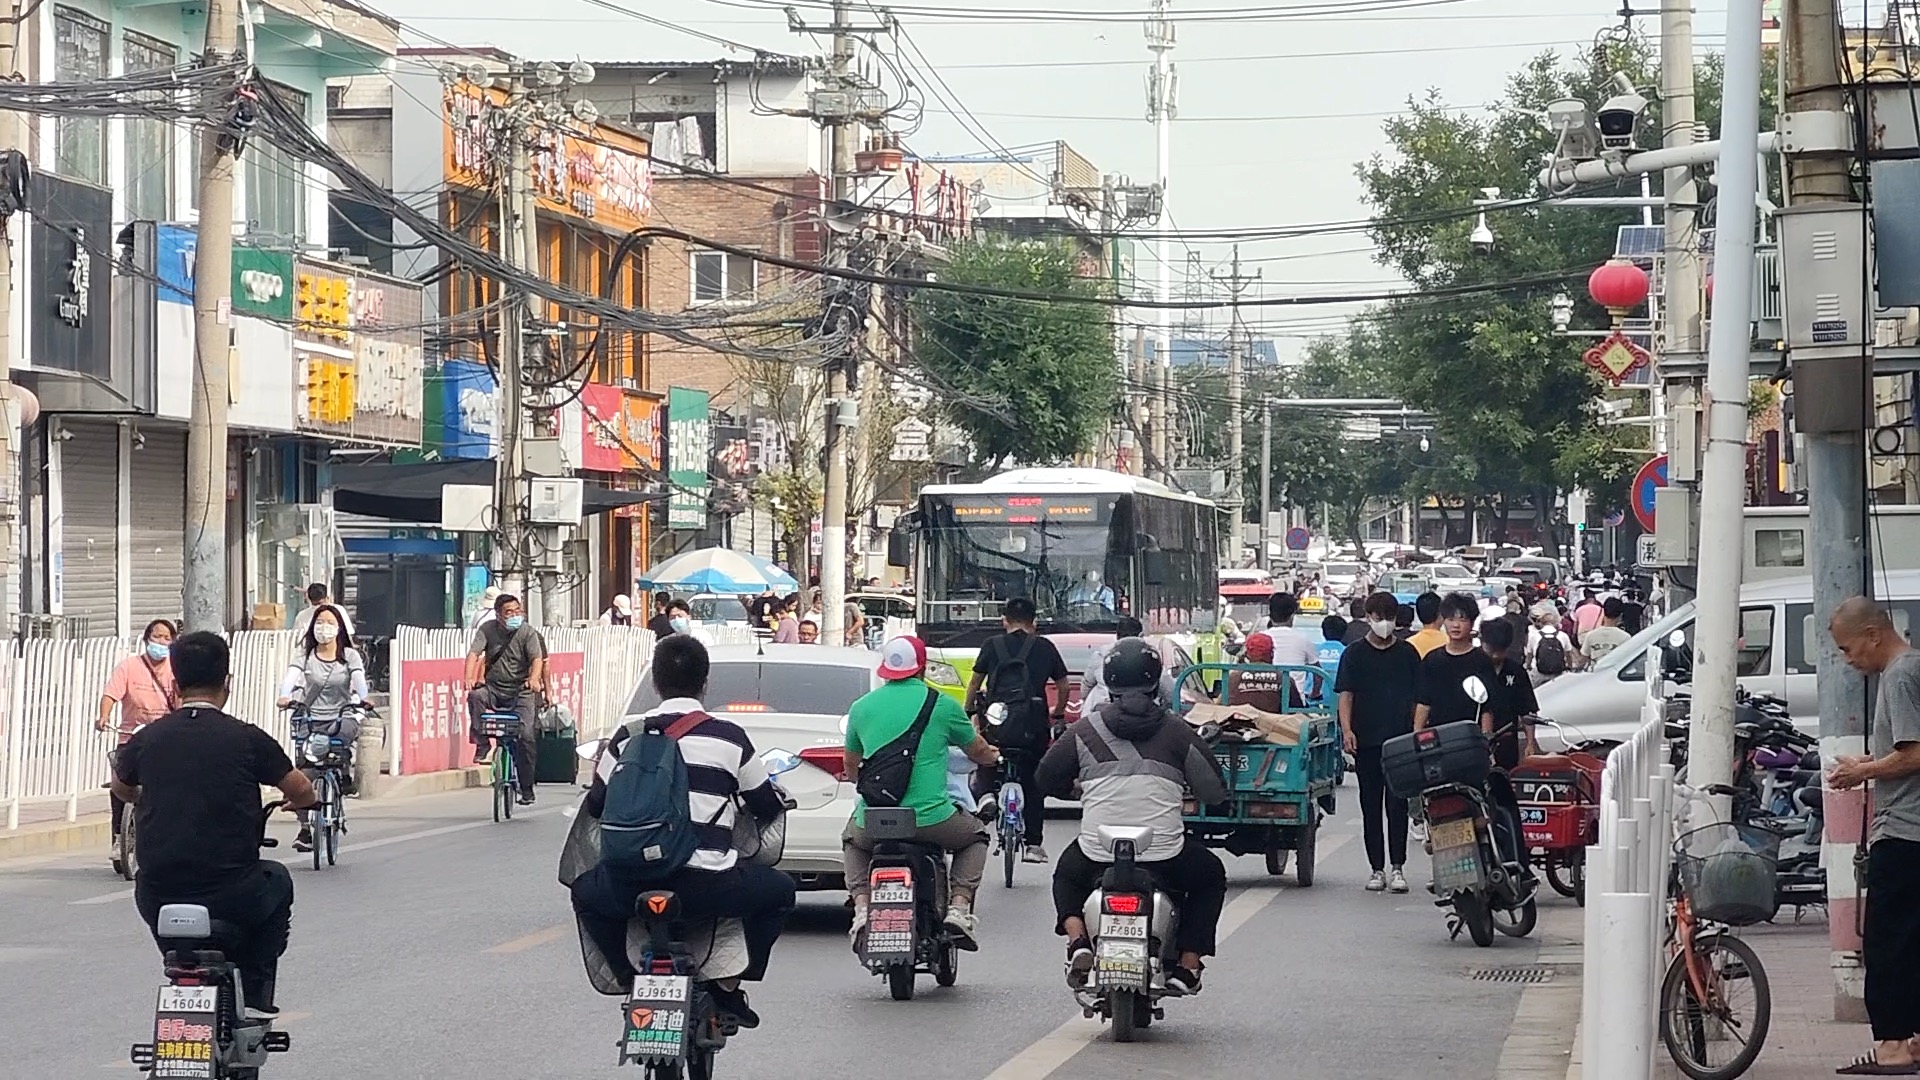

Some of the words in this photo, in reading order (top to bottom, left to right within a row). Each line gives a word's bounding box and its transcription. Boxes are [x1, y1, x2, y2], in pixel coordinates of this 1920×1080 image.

[1302, 600, 1321, 608] TAXI
[874, 890, 910, 900] EW2342
[173, 989, 203, 998] 北京
[637, 988, 682, 998] GJ9613
[163, 998, 211, 1010] L16040
[651, 1009, 685, 1030] 雅迪
